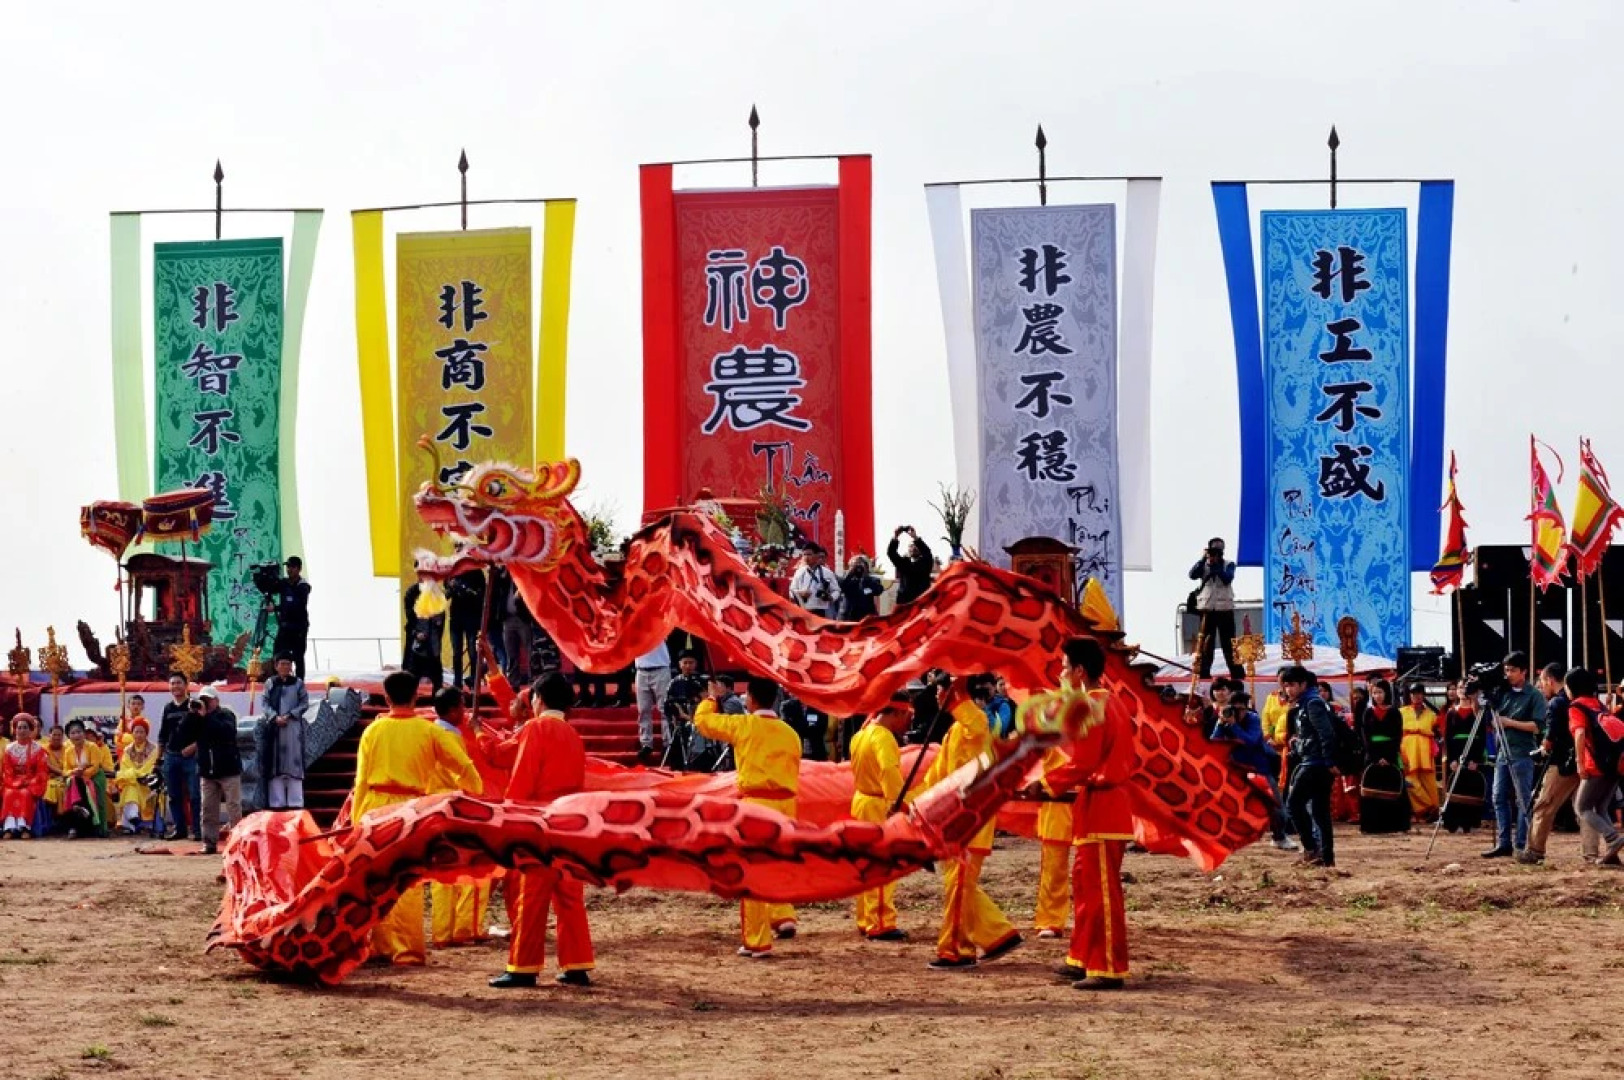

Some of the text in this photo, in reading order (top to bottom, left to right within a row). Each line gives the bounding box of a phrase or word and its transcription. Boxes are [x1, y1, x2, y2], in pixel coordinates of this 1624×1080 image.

[702, 246, 812, 434] 神農
[1310, 244, 1386, 502] 非工不盛
